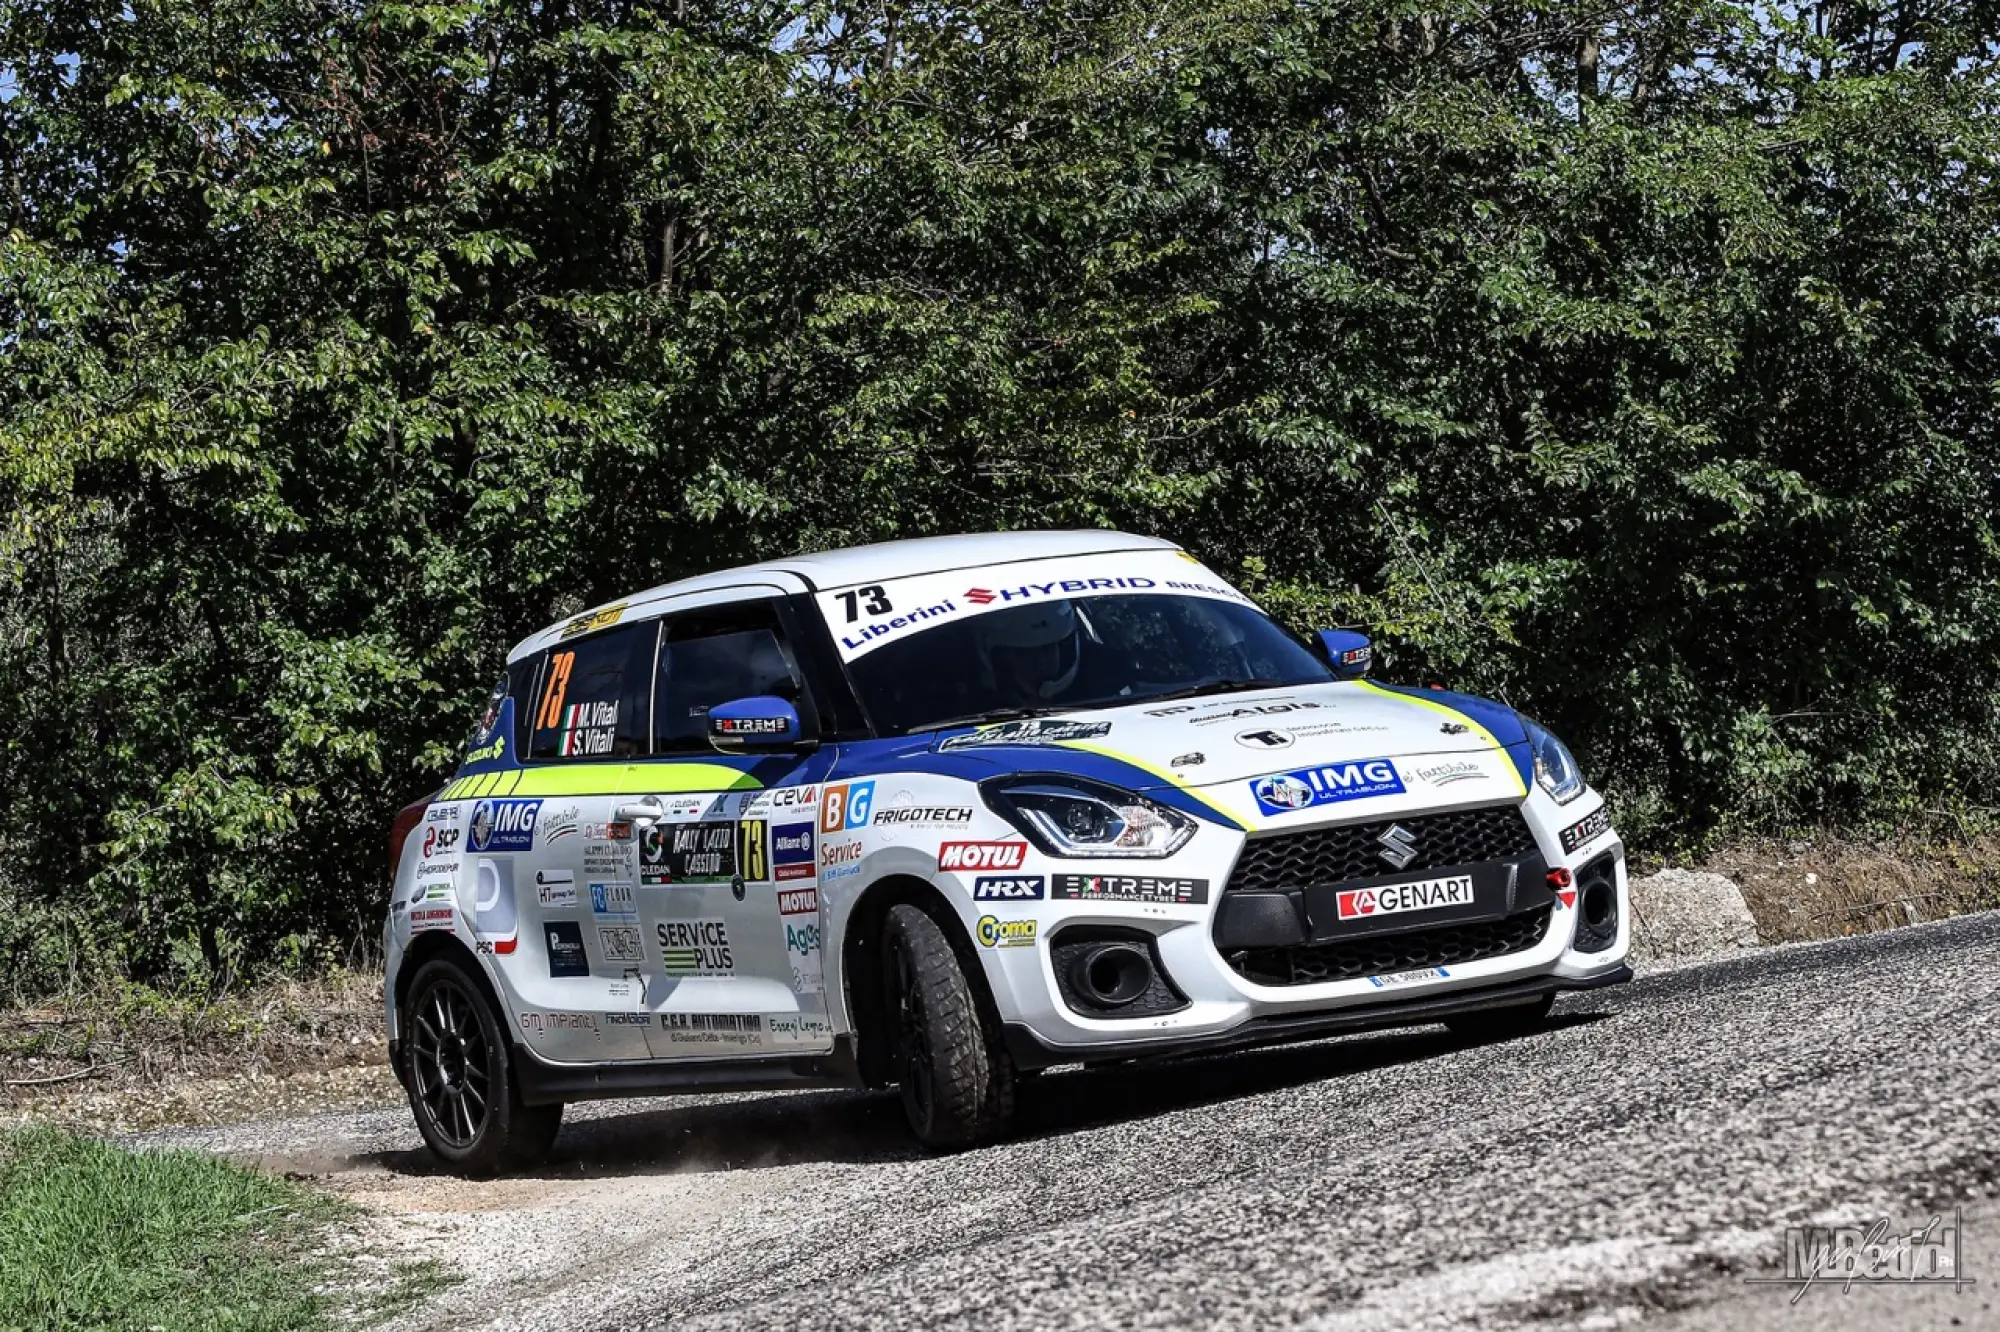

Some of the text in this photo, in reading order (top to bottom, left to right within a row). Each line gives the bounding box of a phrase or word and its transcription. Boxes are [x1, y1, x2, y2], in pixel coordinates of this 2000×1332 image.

[835, 585, 893, 623] 73
[842, 599, 957, 649] Liberini
[1000, 577, 1156, 602] HYBRID
[536, 651, 576, 730] 73
[715, 718, 786, 731] EXTREME
[572, 727, 615, 756] S. Vitali
[1308, 762, 1395, 791] IMG
[494, 803, 538, 832] IMG
[873, 808, 972, 826] FRIGOTECH
[437, 828, 460, 848] SCP
[740, 820, 765, 881] 73
[775, 836, 801, 851] Allianz
[821, 838, 862, 868] Service
[940, 844, 1022, 869] MOTUL
[977, 880, 1041, 898] HRX
[1066, 875, 1194, 897] EXTREME
[1379, 878, 1471, 911] GENART
[781, 891, 817, 912] MOTUL
[476, 941, 493, 954] PSC
[694, 947, 734, 969] PLUS
